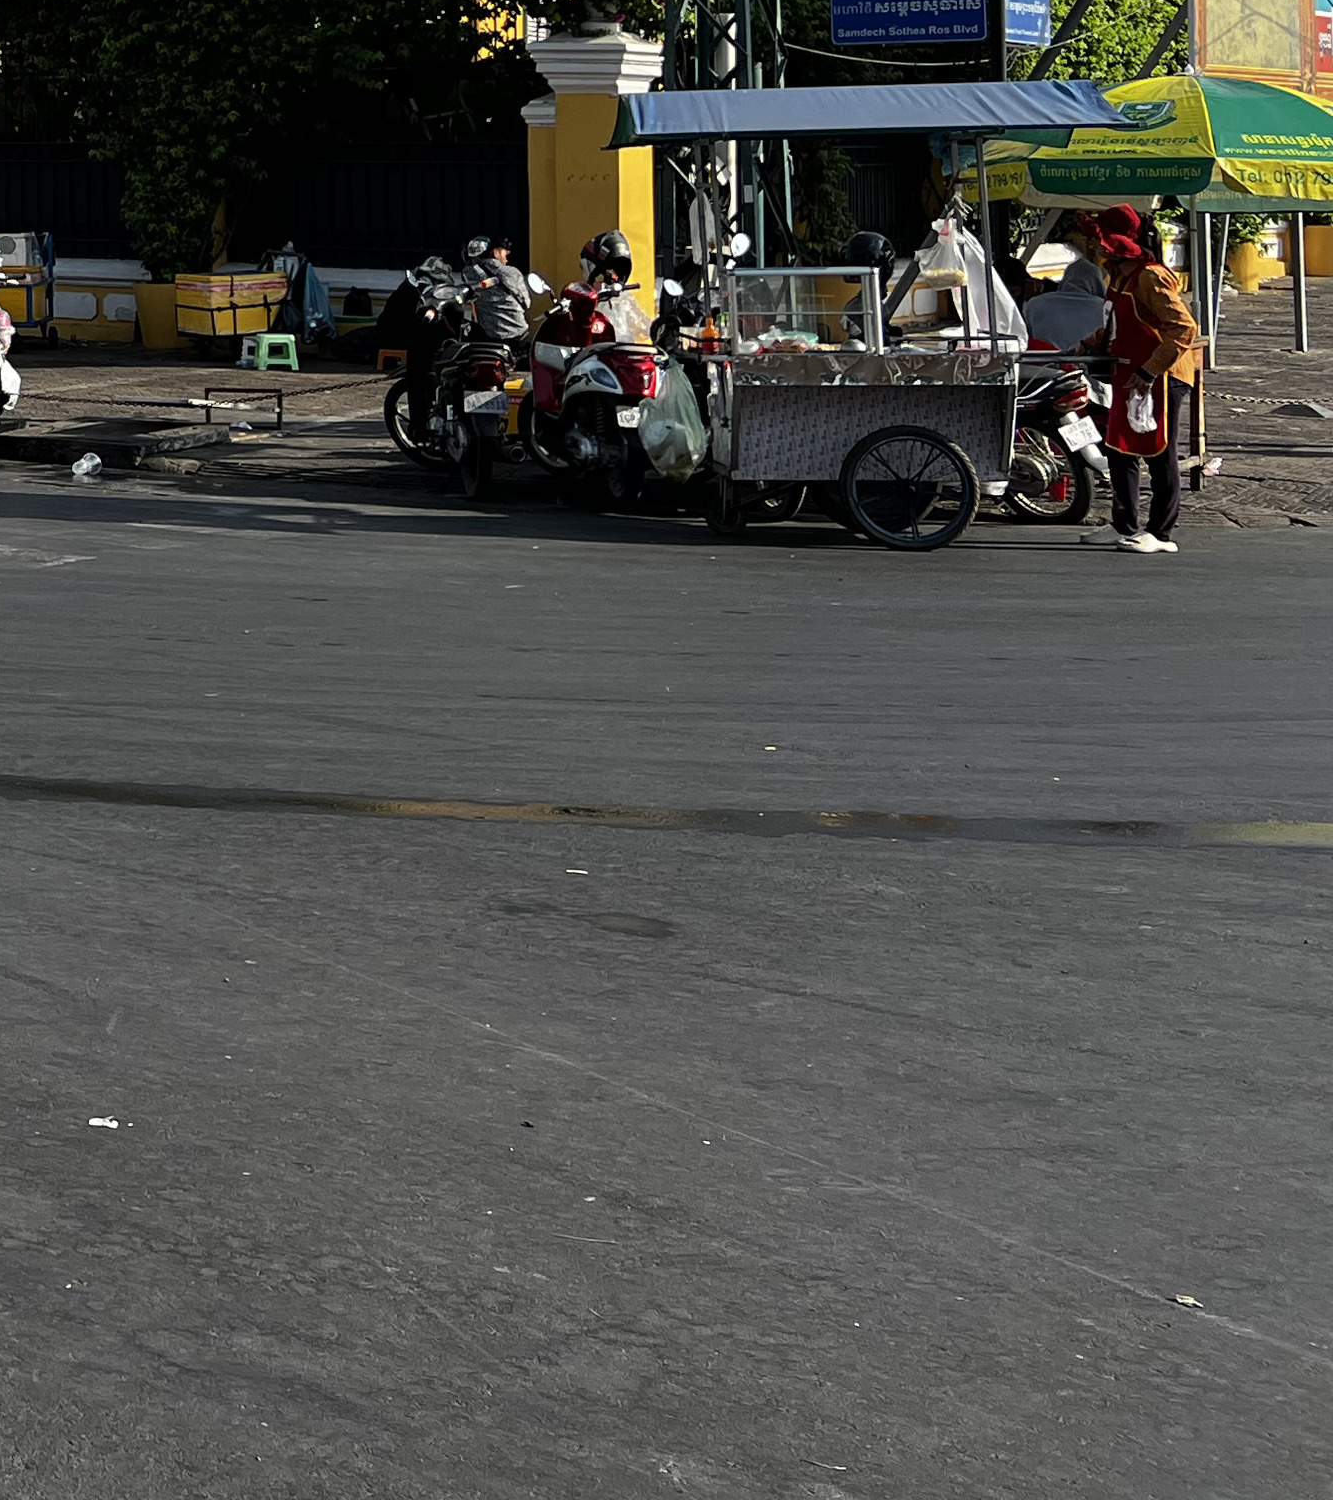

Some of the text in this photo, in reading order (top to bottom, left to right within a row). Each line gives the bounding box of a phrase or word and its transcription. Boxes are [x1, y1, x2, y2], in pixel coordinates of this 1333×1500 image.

[837, 24, 979, 38] Samdech Sothea Ros Blvd
